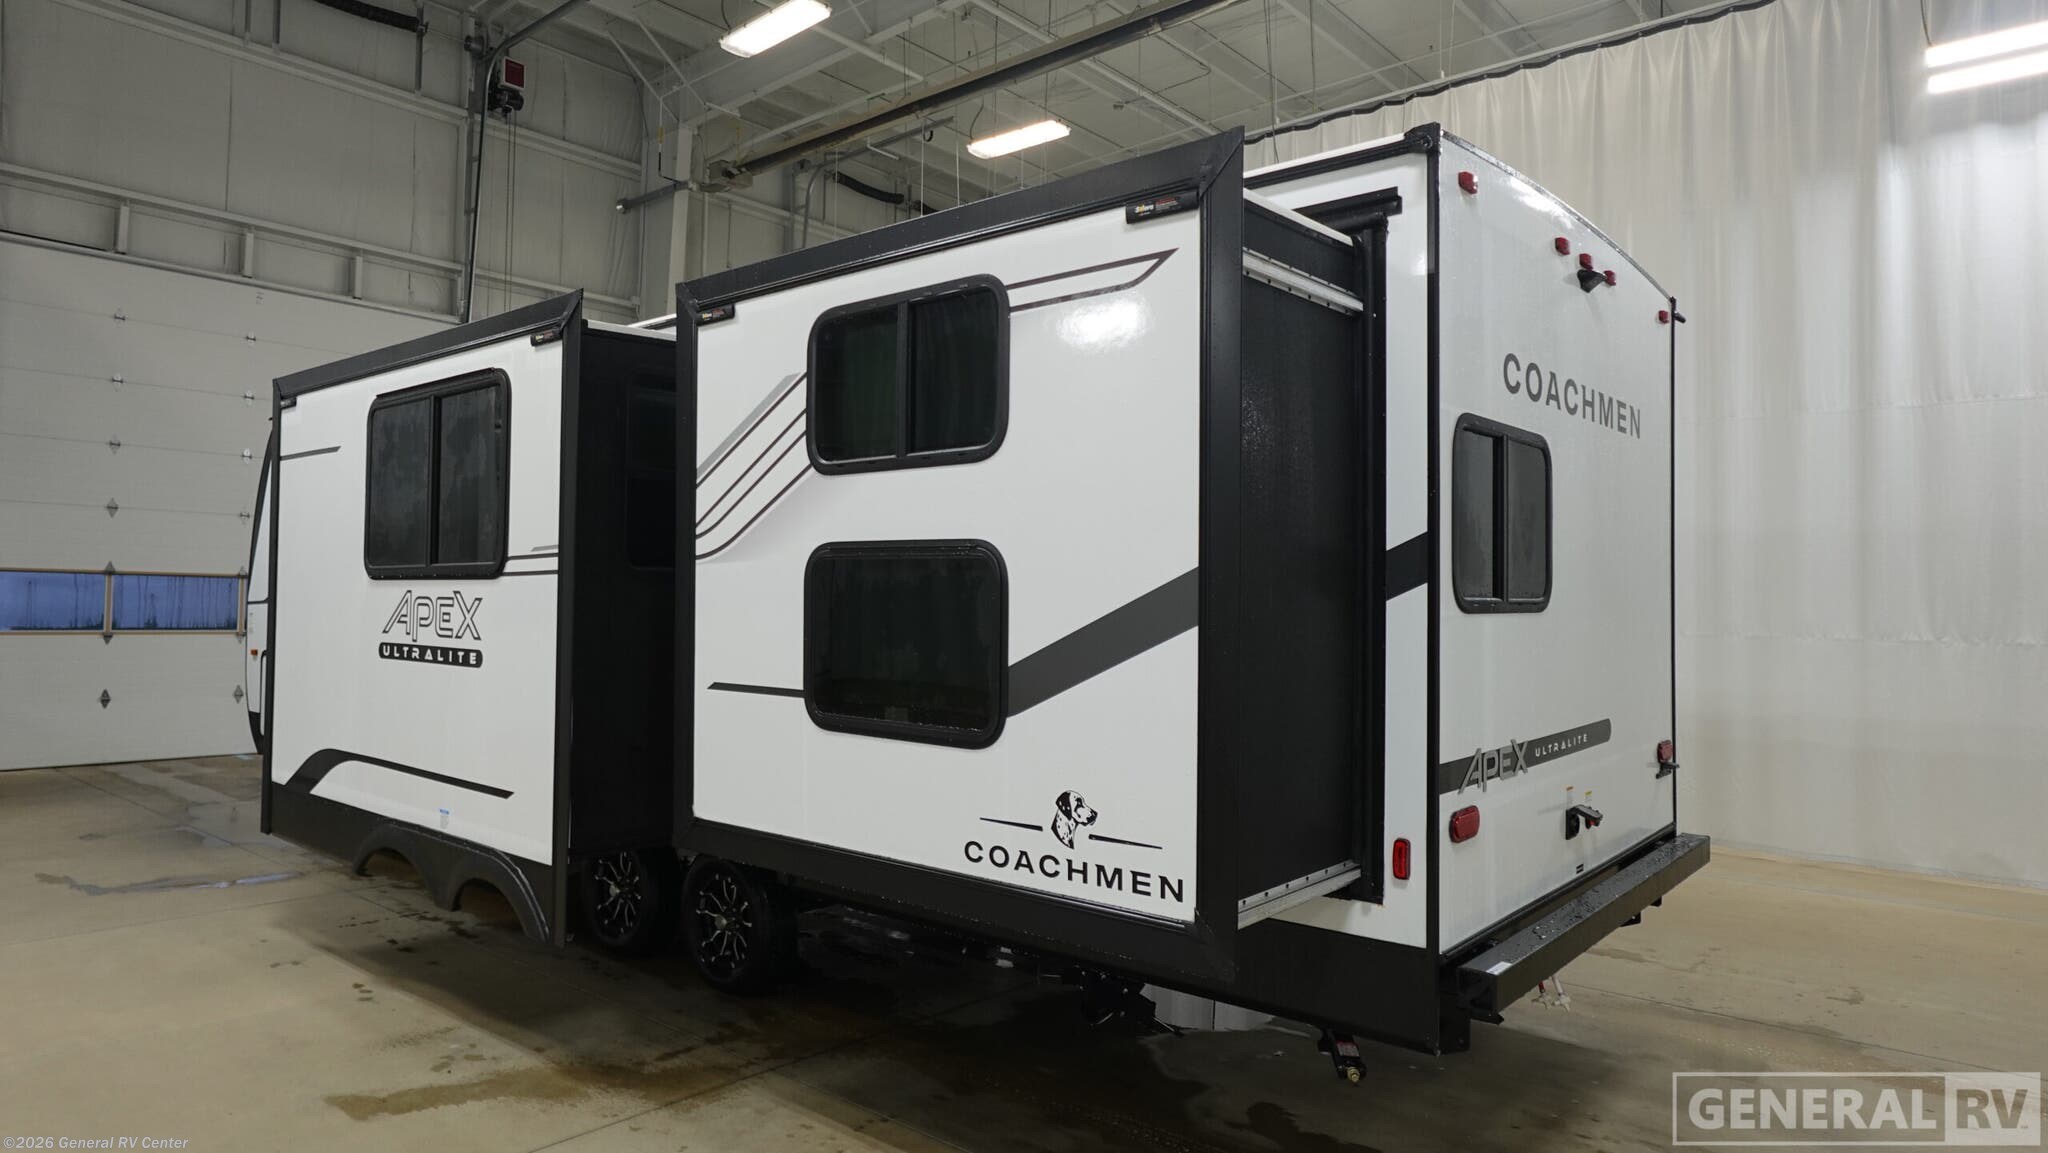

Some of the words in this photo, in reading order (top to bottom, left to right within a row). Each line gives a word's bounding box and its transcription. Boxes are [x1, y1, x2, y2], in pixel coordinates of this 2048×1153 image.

[1503, 352, 1641, 440] COACHMEN
[382, 589, 483, 643] APEX
[383, 645, 477, 665] ULTRALITE
[1457, 739, 1529, 794] APEX
[1535, 733, 1589, 759] ULTRALITE
[964, 840, 1184, 903] COACHMEN
